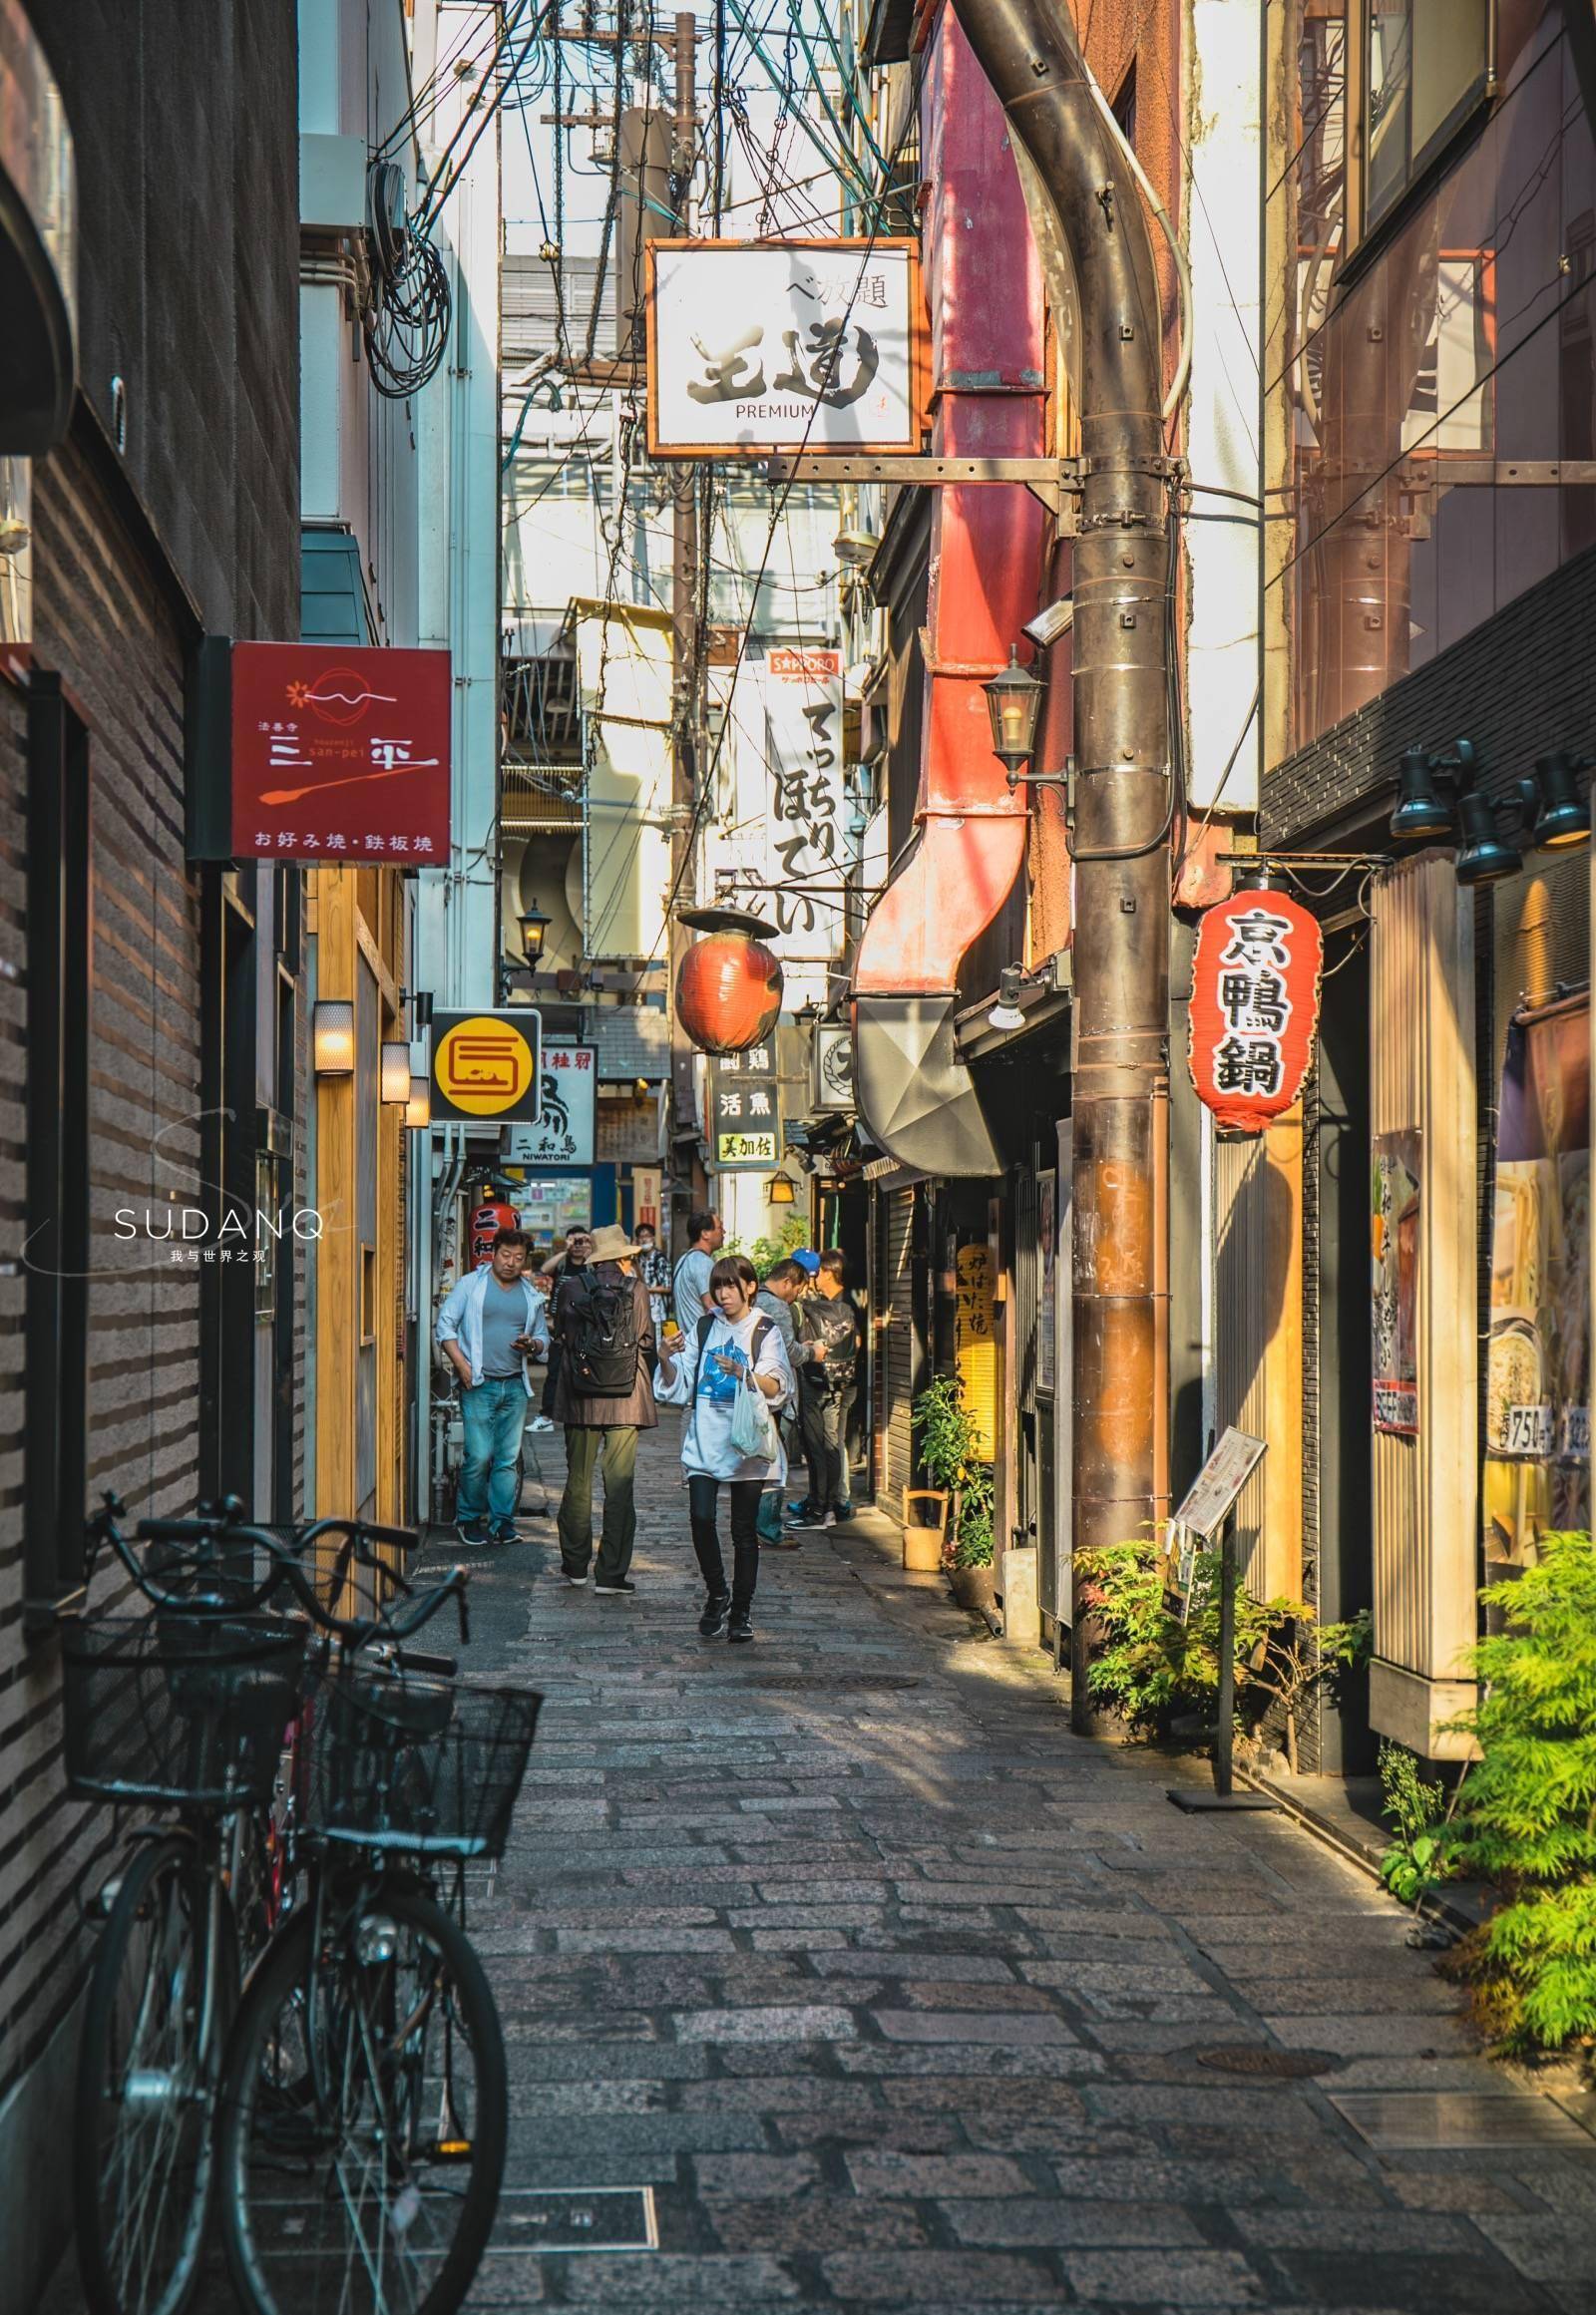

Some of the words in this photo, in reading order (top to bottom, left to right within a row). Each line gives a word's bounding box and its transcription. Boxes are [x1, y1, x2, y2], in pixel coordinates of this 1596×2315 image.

[735, 404, 816, 419] PREMIUM
[257, 721, 298, 732] 法善寺
[308, 746, 365, 759] san-pei
[802, 703, 836, 861] てっちり
[773, 768, 816, 935] ほてい
[720, 1092, 771, 1116] 活魚
[522, 1153, 571, 1162] NIWATORI
